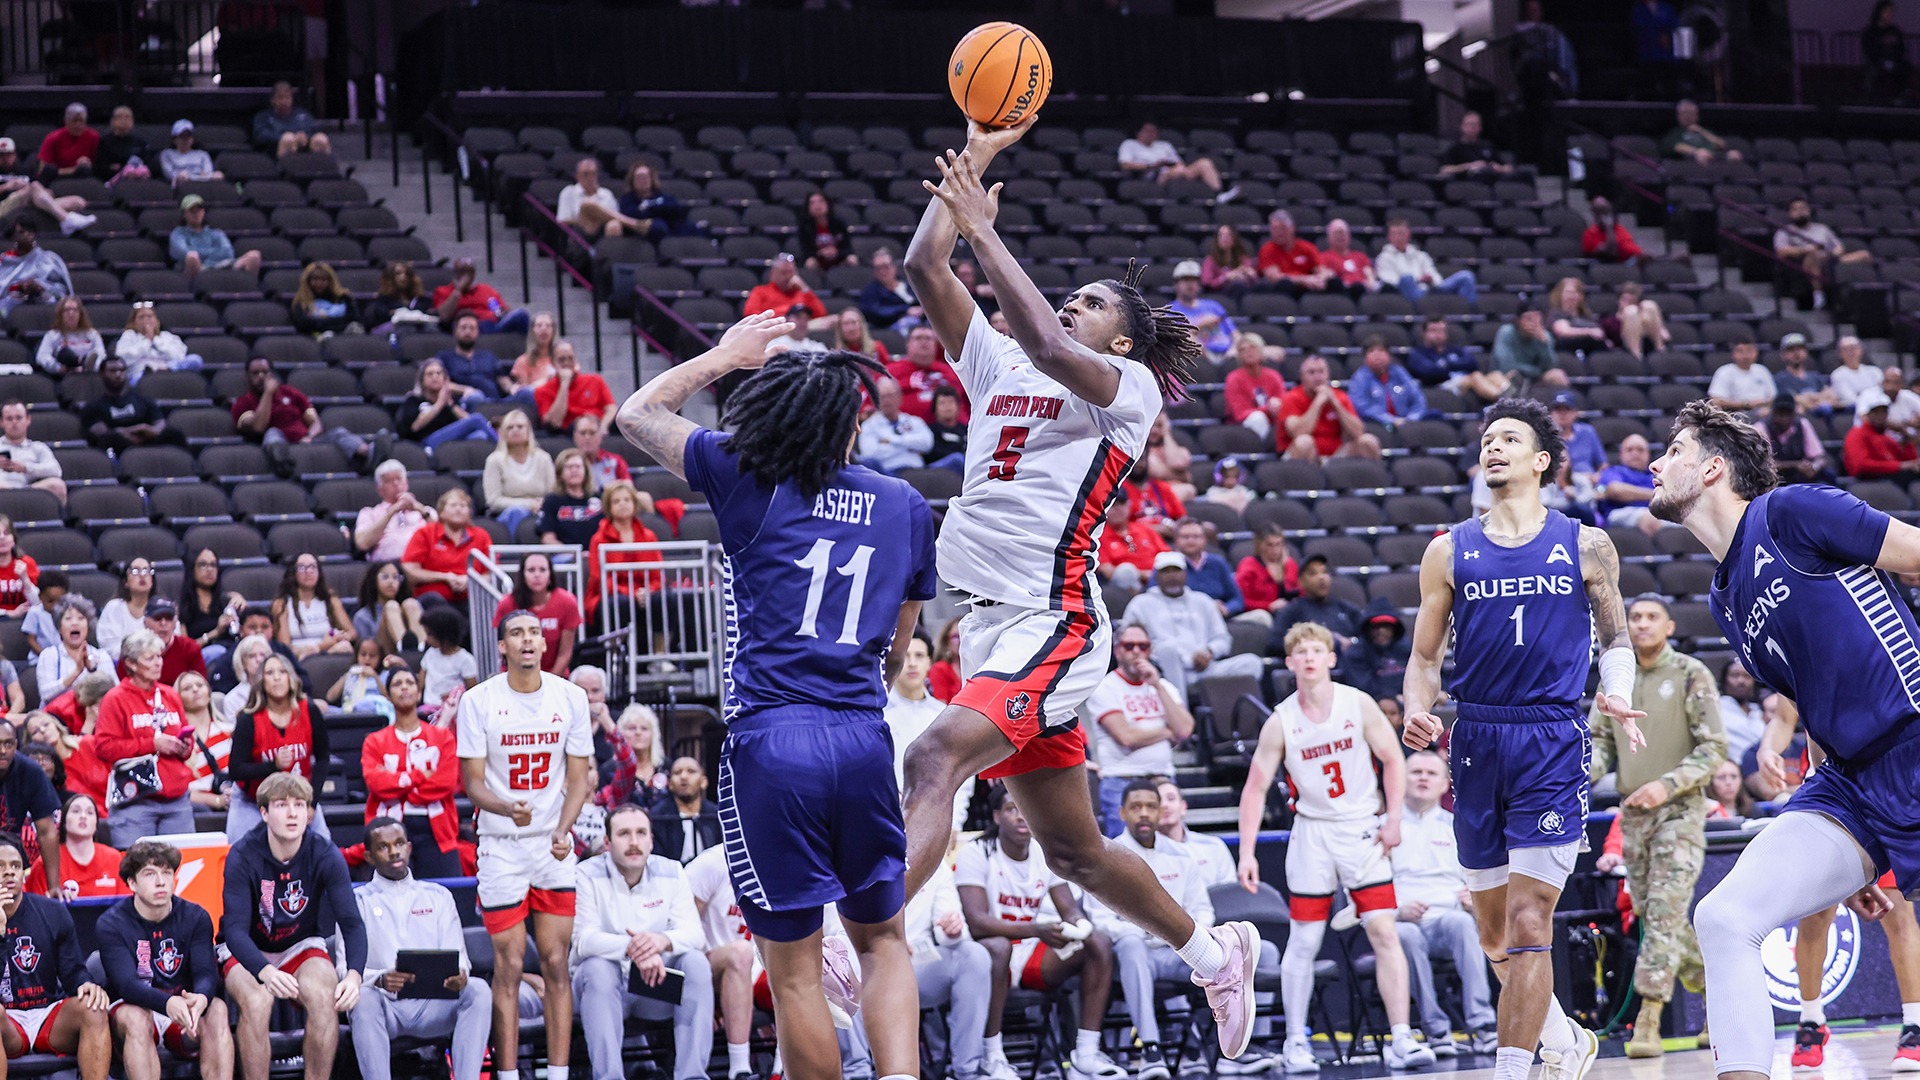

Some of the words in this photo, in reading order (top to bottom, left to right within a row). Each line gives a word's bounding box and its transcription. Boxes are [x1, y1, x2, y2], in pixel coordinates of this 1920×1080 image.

[1000, 63, 1039, 122] Wilson
[985, 394, 1031, 418] AUSTIN
[1028, 395, 1065, 421] PEAY
[987, 425, 1030, 481] 5
[811, 487, 877, 526] ASHBY
[793, 537, 877, 646] 11
[1463, 575, 1574, 601] QUEENS
[1508, 604, 1526, 647] 1
[500, 732, 536, 747] AUSTIN
[537, 731, 560, 745] PEAY
[1300, 743, 1332, 761] AUSTIN
[1332, 736, 1353, 754] PEAY
[508, 751, 552, 791] 22
[1321, 760, 1346, 799] 3
